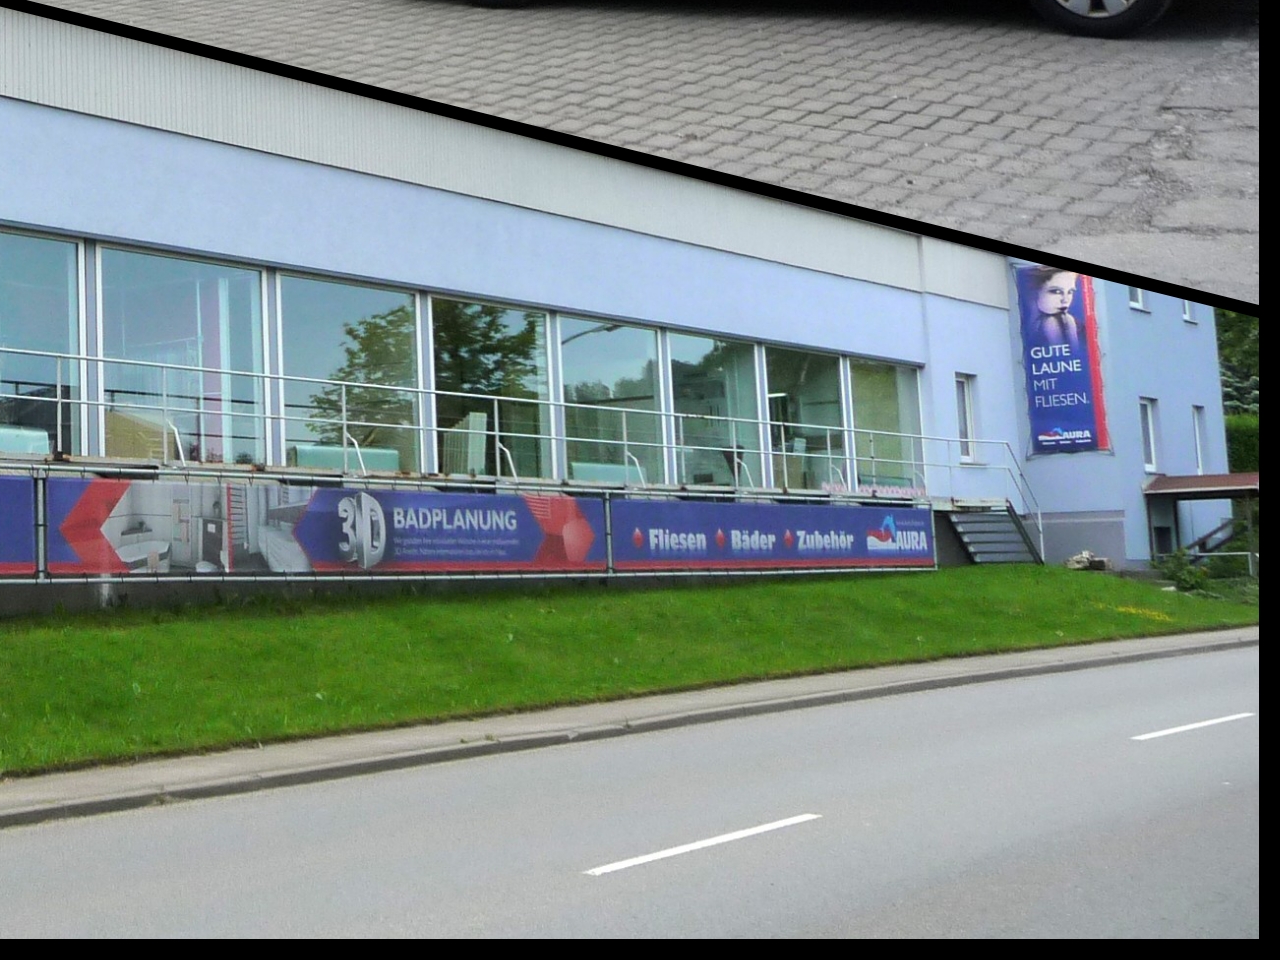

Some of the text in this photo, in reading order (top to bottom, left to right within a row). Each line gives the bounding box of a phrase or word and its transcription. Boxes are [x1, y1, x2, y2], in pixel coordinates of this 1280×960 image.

[1030, 343, 1071, 359] GUTE
[1032, 359, 1082, 375] LAUNE
[1033, 378, 1058, 392] MIT
[1035, 392, 1090, 408] FLIESEN.
[336, 492, 518, 570] 3D BADPLANUNG
[649, 528, 928, 550] Fliesen Bäder Zubehör LAURA
